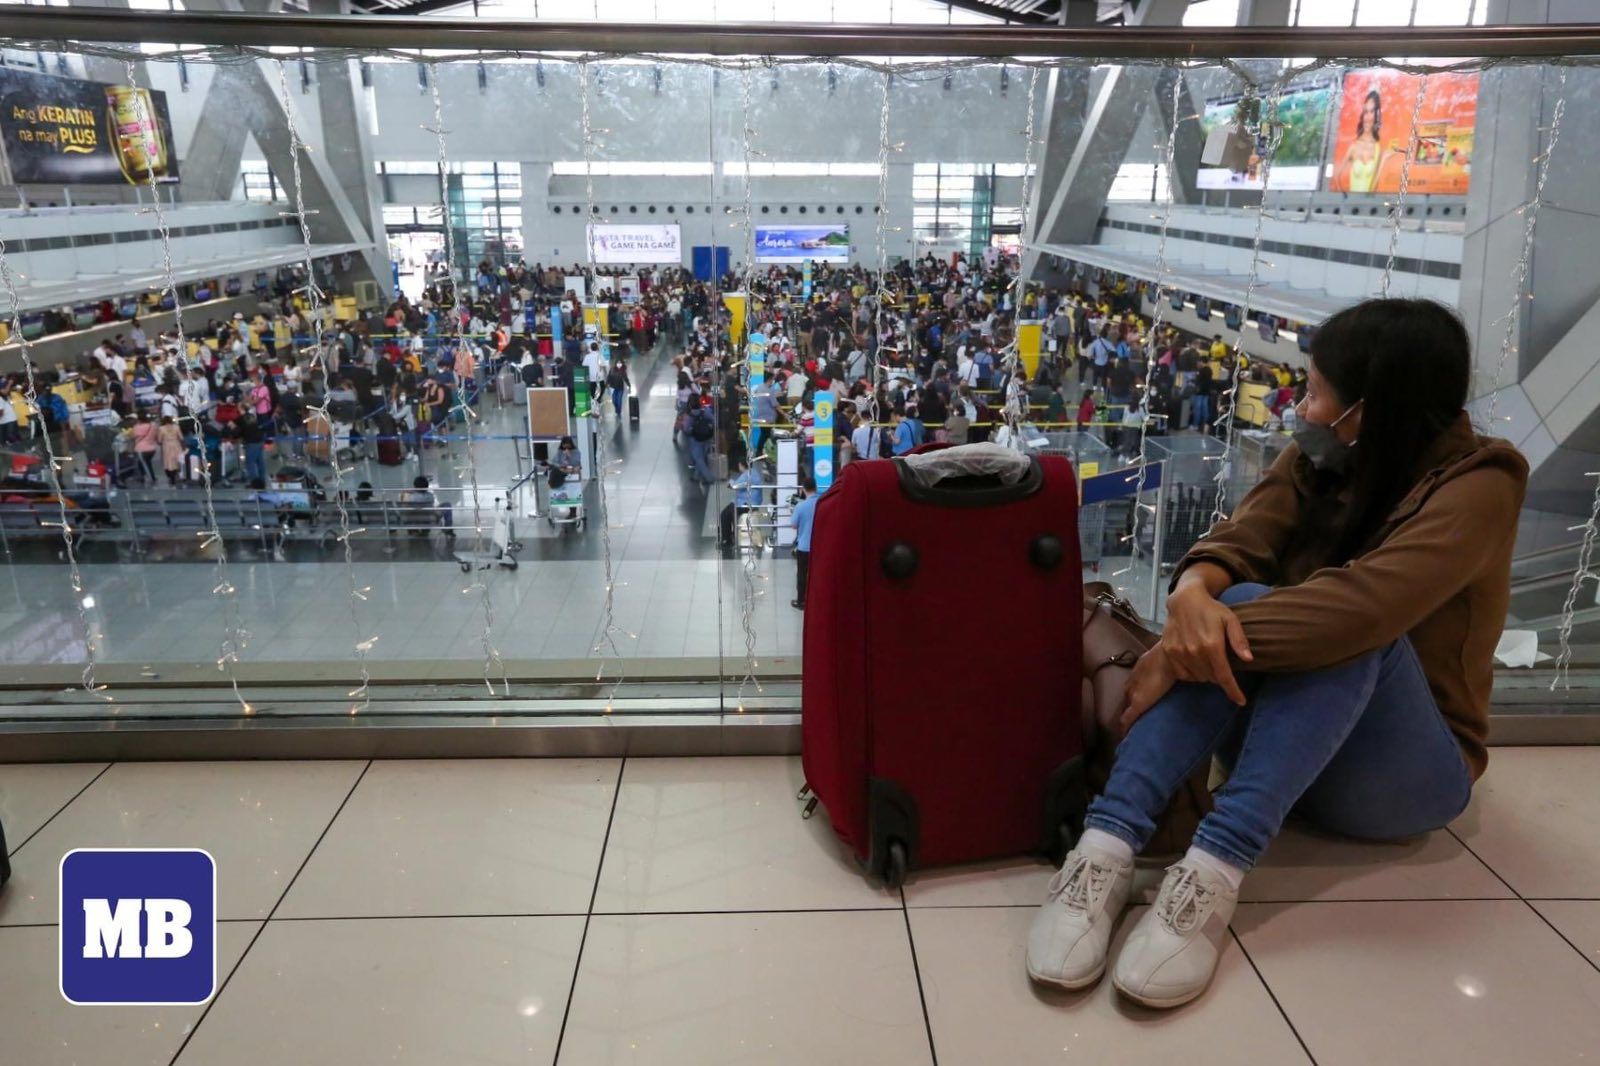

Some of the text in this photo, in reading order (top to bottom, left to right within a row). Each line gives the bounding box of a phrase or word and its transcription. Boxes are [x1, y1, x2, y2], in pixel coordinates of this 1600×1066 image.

[13, 105, 37, 124] Ang
[38, 105, 96, 125] KERATIN
[19, 130, 33, 142] na
[60, 127, 97, 145] PLUS!
[621, 234, 654, 242] TRAVEL
[610, 241, 635, 249] GAME
[651, 241, 676, 249] GAME
